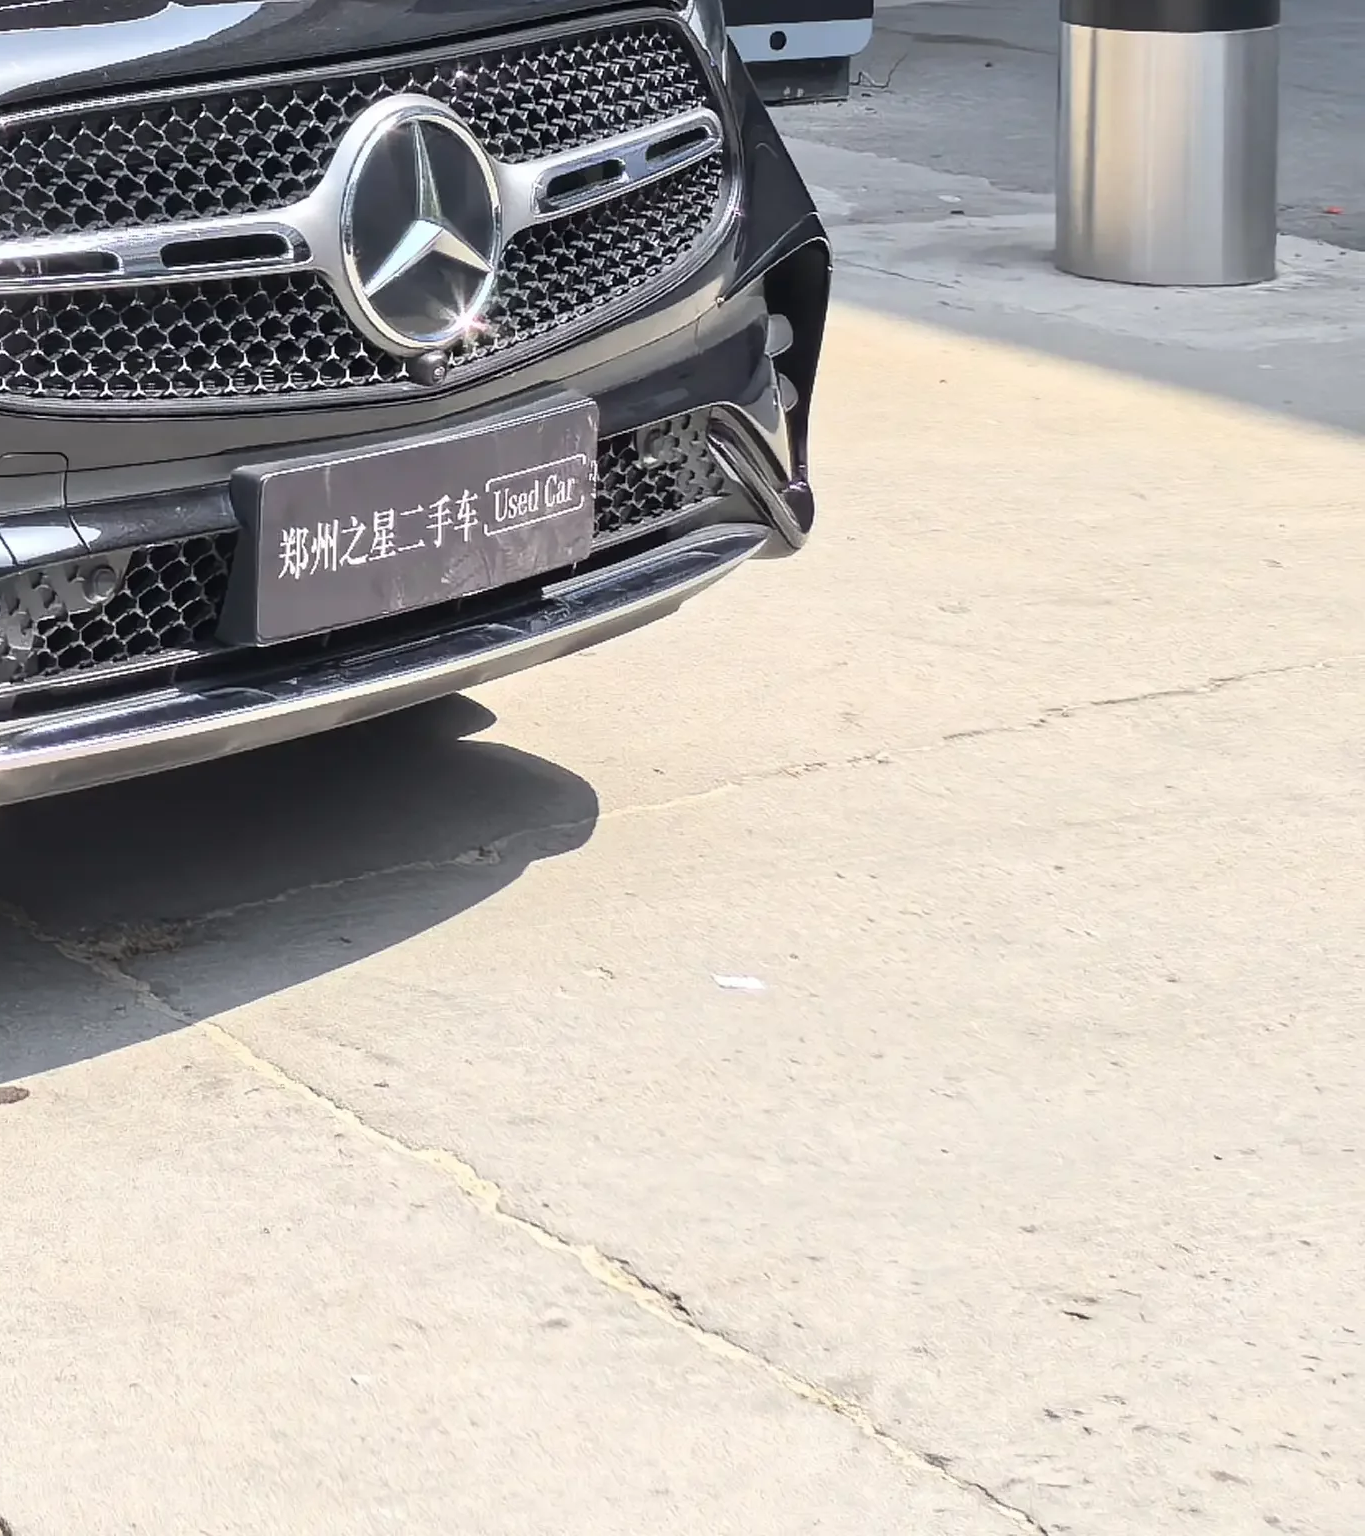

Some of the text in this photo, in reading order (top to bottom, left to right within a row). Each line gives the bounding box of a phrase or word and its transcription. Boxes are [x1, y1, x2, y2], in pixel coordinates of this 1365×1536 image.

[277, 472, 577, 580] 郑州之星二手车 Used Car
